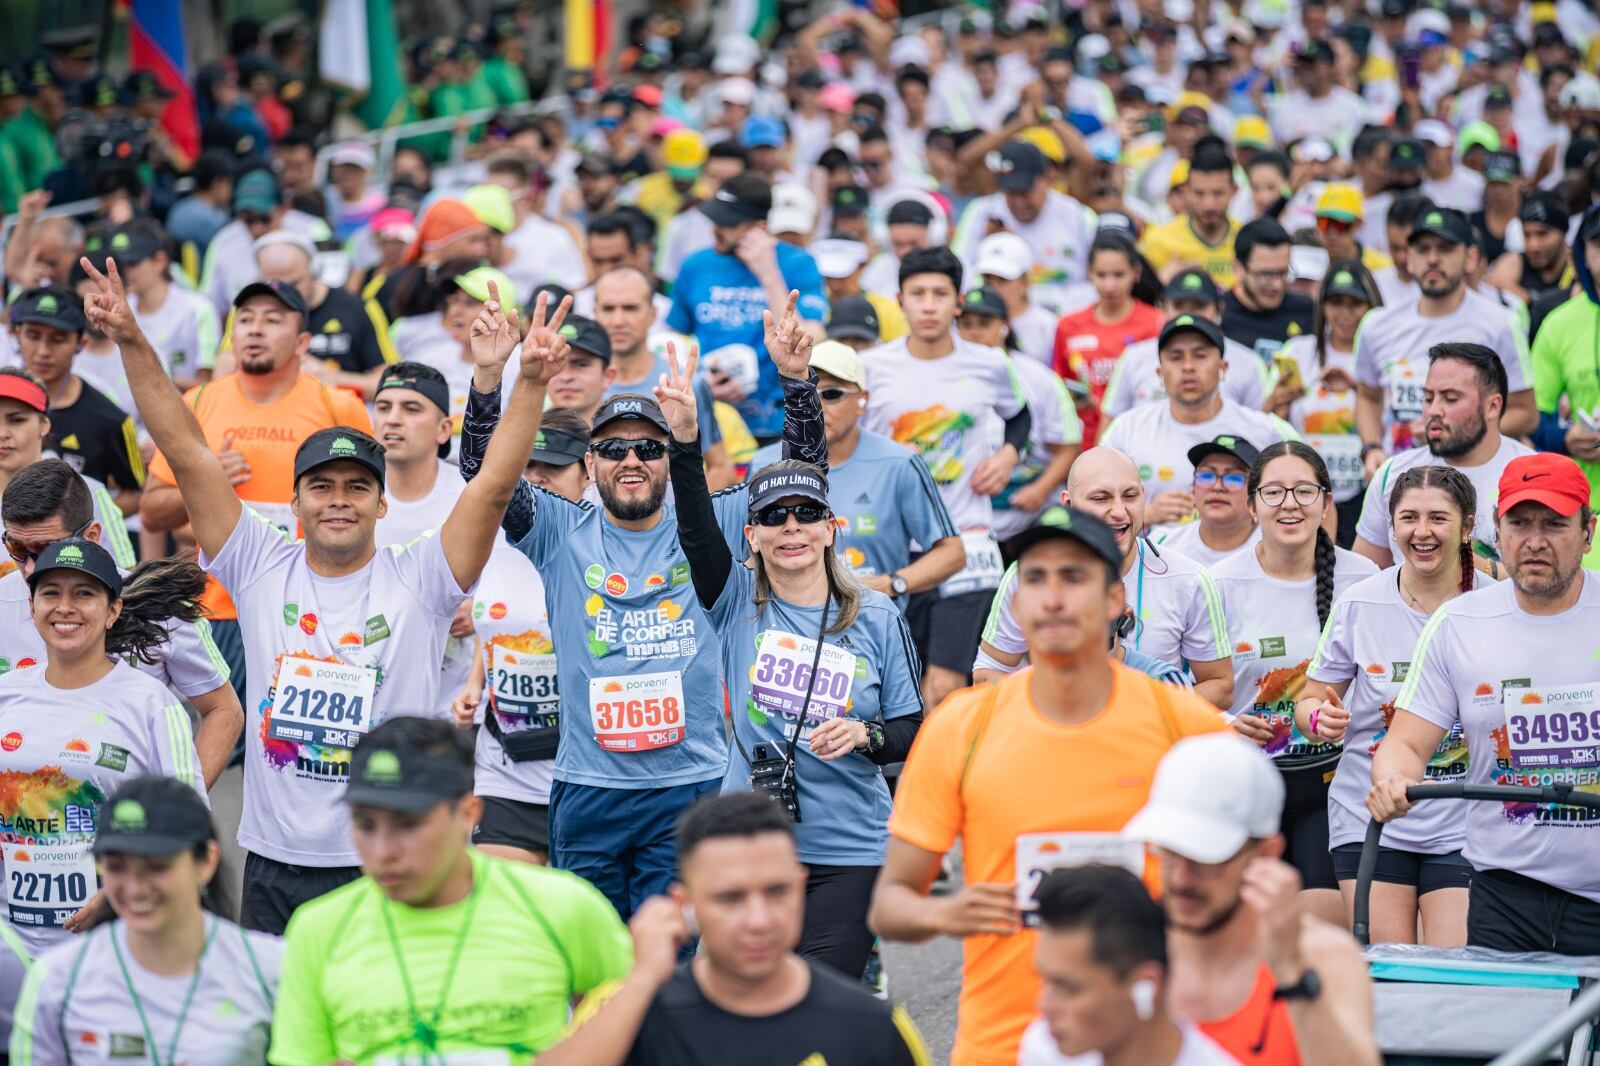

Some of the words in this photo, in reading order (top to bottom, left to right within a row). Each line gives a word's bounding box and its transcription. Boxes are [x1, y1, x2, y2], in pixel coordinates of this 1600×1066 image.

[758, 480, 769, 494] NO
[770, 475, 789, 488] HAY
[789, 473, 822, 490] LÍMITES
[55, 556, 86, 565] porvenir
[607, 580, 626, 592] easy
[596, 608, 613, 625] EL
[621, 608, 669, 628] ARTE
[595, 621, 618, 644] DE
[621, 618, 696, 643] CORRER
[800, 643, 845, 663] povenir
[316, 669, 362, 683] porvenir
[626, 678, 669, 693] porvenir
[756, 653, 850, 701] 33660
[279, 685, 364, 726] 21284
[1547, 690, 1594, 705] porvenir
[595, 696, 681, 730] 37658
[59, 751, 92, 762] porvenir
[1571, 749, 1595, 760] 10K
[297, 756, 350, 777] mm
[1504, 773, 1525, 786] DE
[1527, 770, 1599, 787] CORRER
[16, 815, 60, 834] ARTE
[33, 851, 79, 863] porvenir
[11, 870, 88, 903] 22710
